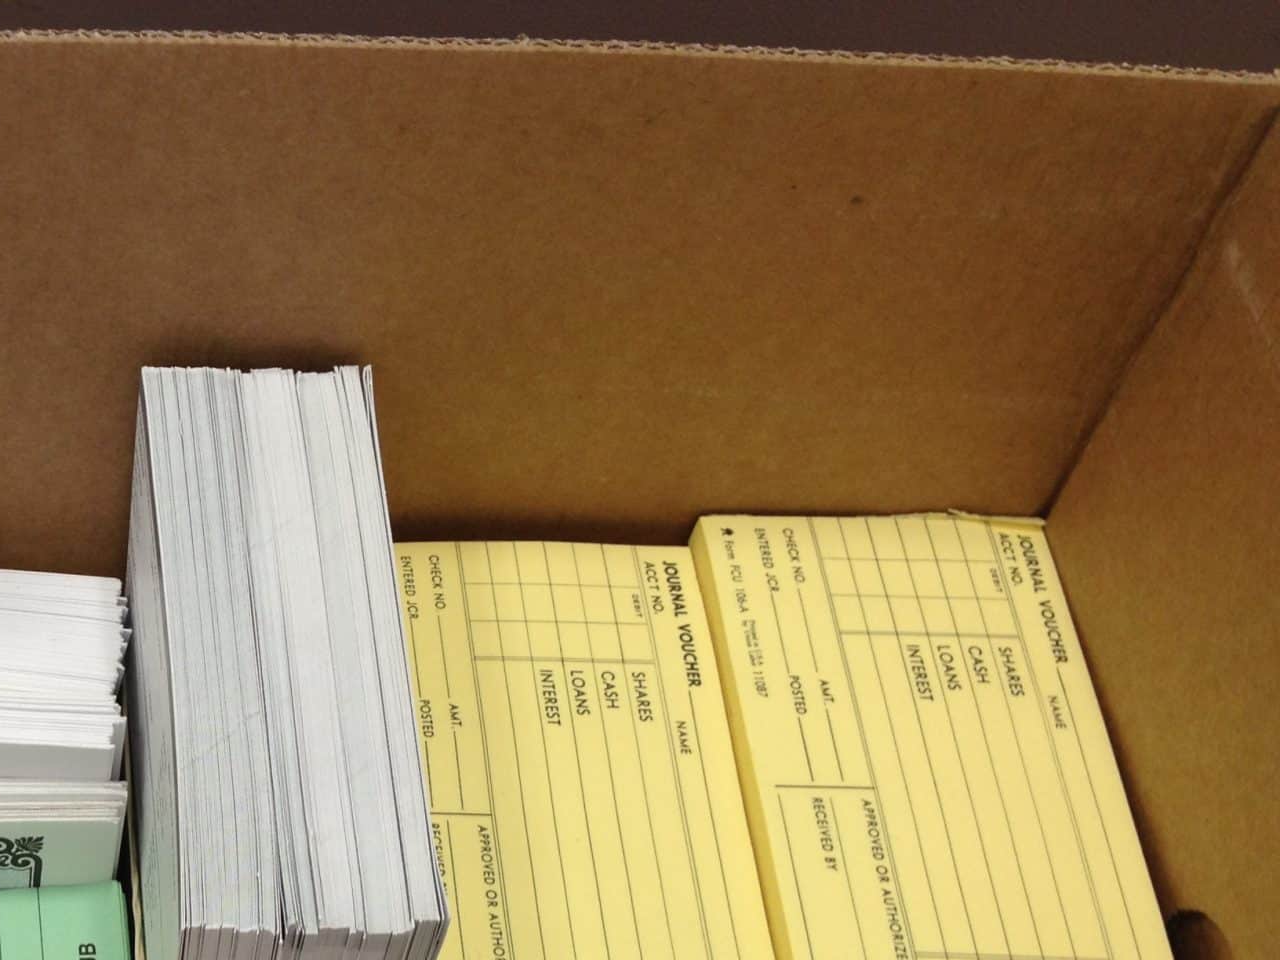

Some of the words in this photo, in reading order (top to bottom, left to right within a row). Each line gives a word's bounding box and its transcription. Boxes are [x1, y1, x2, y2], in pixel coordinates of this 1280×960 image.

[754, 528, 774, 572] ENTERED
[782, 528, 800, 562] CHECK
[400, 556, 417, 597] ENTERED
[428, 554, 443, 590] CHECK
[407, 598, 419, 620] JCR
[1017, 534, 1046, 593] JOURNAL
[1039, 600, 1068, 664] VOUCHER
[662, 561, 687, 617] JOURNAL
[678, 624, 702, 688] VOUCHER
[906, 644, 934, 702] INTEREST
[938, 644, 962, 691] LOANS
[968, 646, 990, 684] CASH
[998, 646, 1024, 697] SHARES
[540, 668, 562, 726] INTEREST
[570, 670, 590, 716] LOANS
[601, 671, 620, 710] CASH
[632, 672, 654, 722] SHARES
[790, 675, 807, 715] POSTED
[1048, 695, 1067, 730] NAME
[420, 700, 434, 738] POSTED
[676, 720, 692, 754] NAME
[812, 797, 834, 853] RECEIVED
[825, 856, 838, 873] BY
[862, 800, 884, 862] APPROVED
[875, 866, 892, 884] OR
[477, 825, 496, 886] APPROVED
[487, 890, 499, 908] OR
